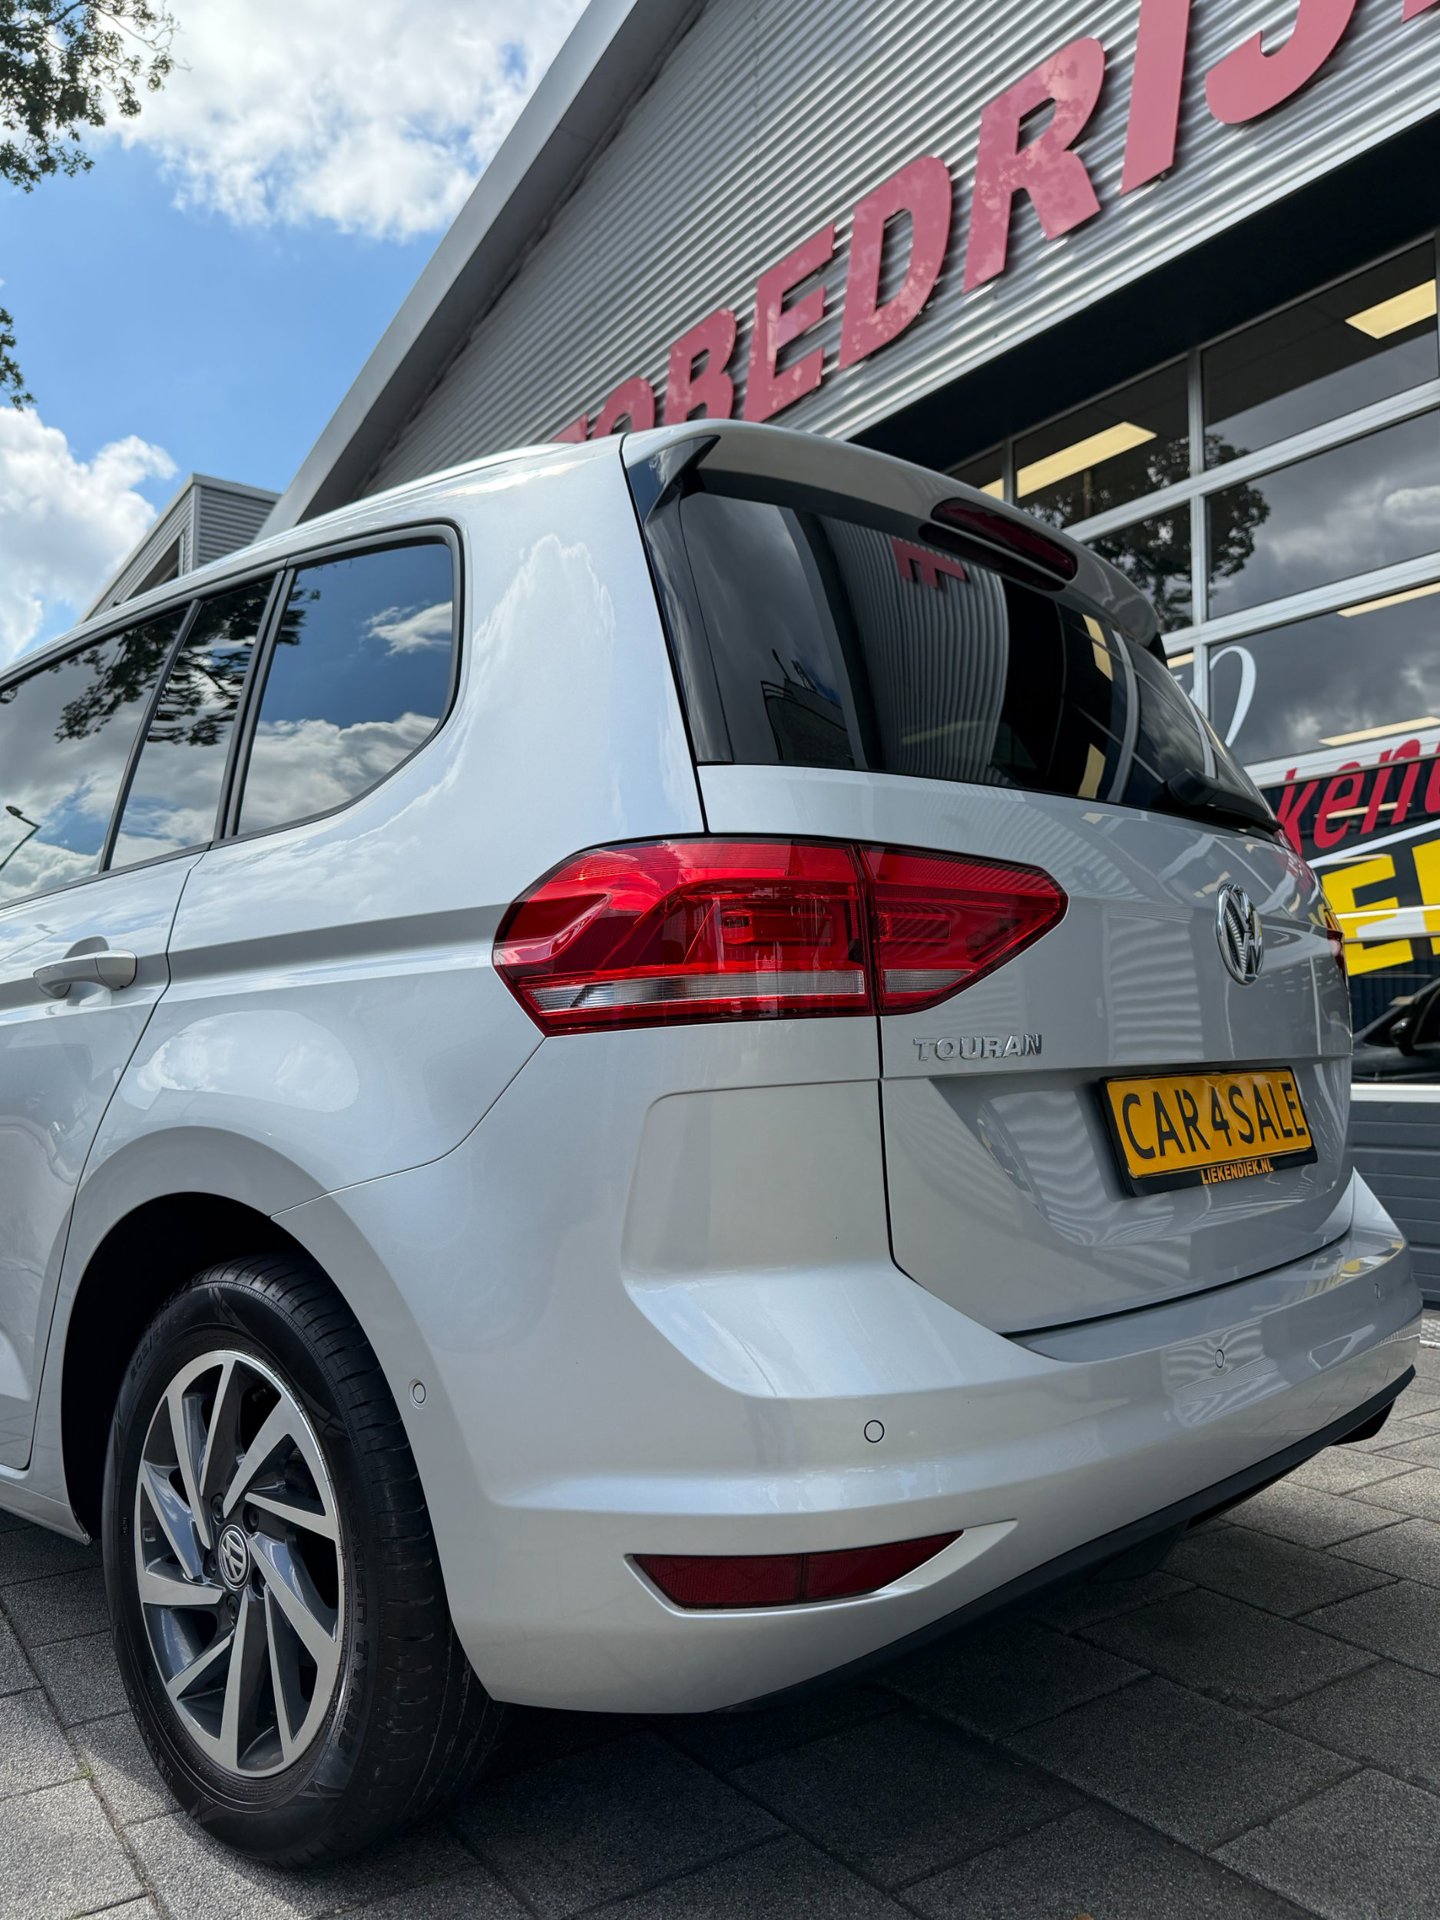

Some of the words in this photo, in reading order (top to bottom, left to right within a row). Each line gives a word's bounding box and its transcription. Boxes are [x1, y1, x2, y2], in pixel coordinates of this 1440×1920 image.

[553, 0, 1440, 443] BEDRIJ
[912, 1033, 1043, 1062] TOURAN
[1121, 1082, 1307, 1160] CAR4SALE
[1201, 1158, 1275, 1185] LIEKENDIEK.NL
